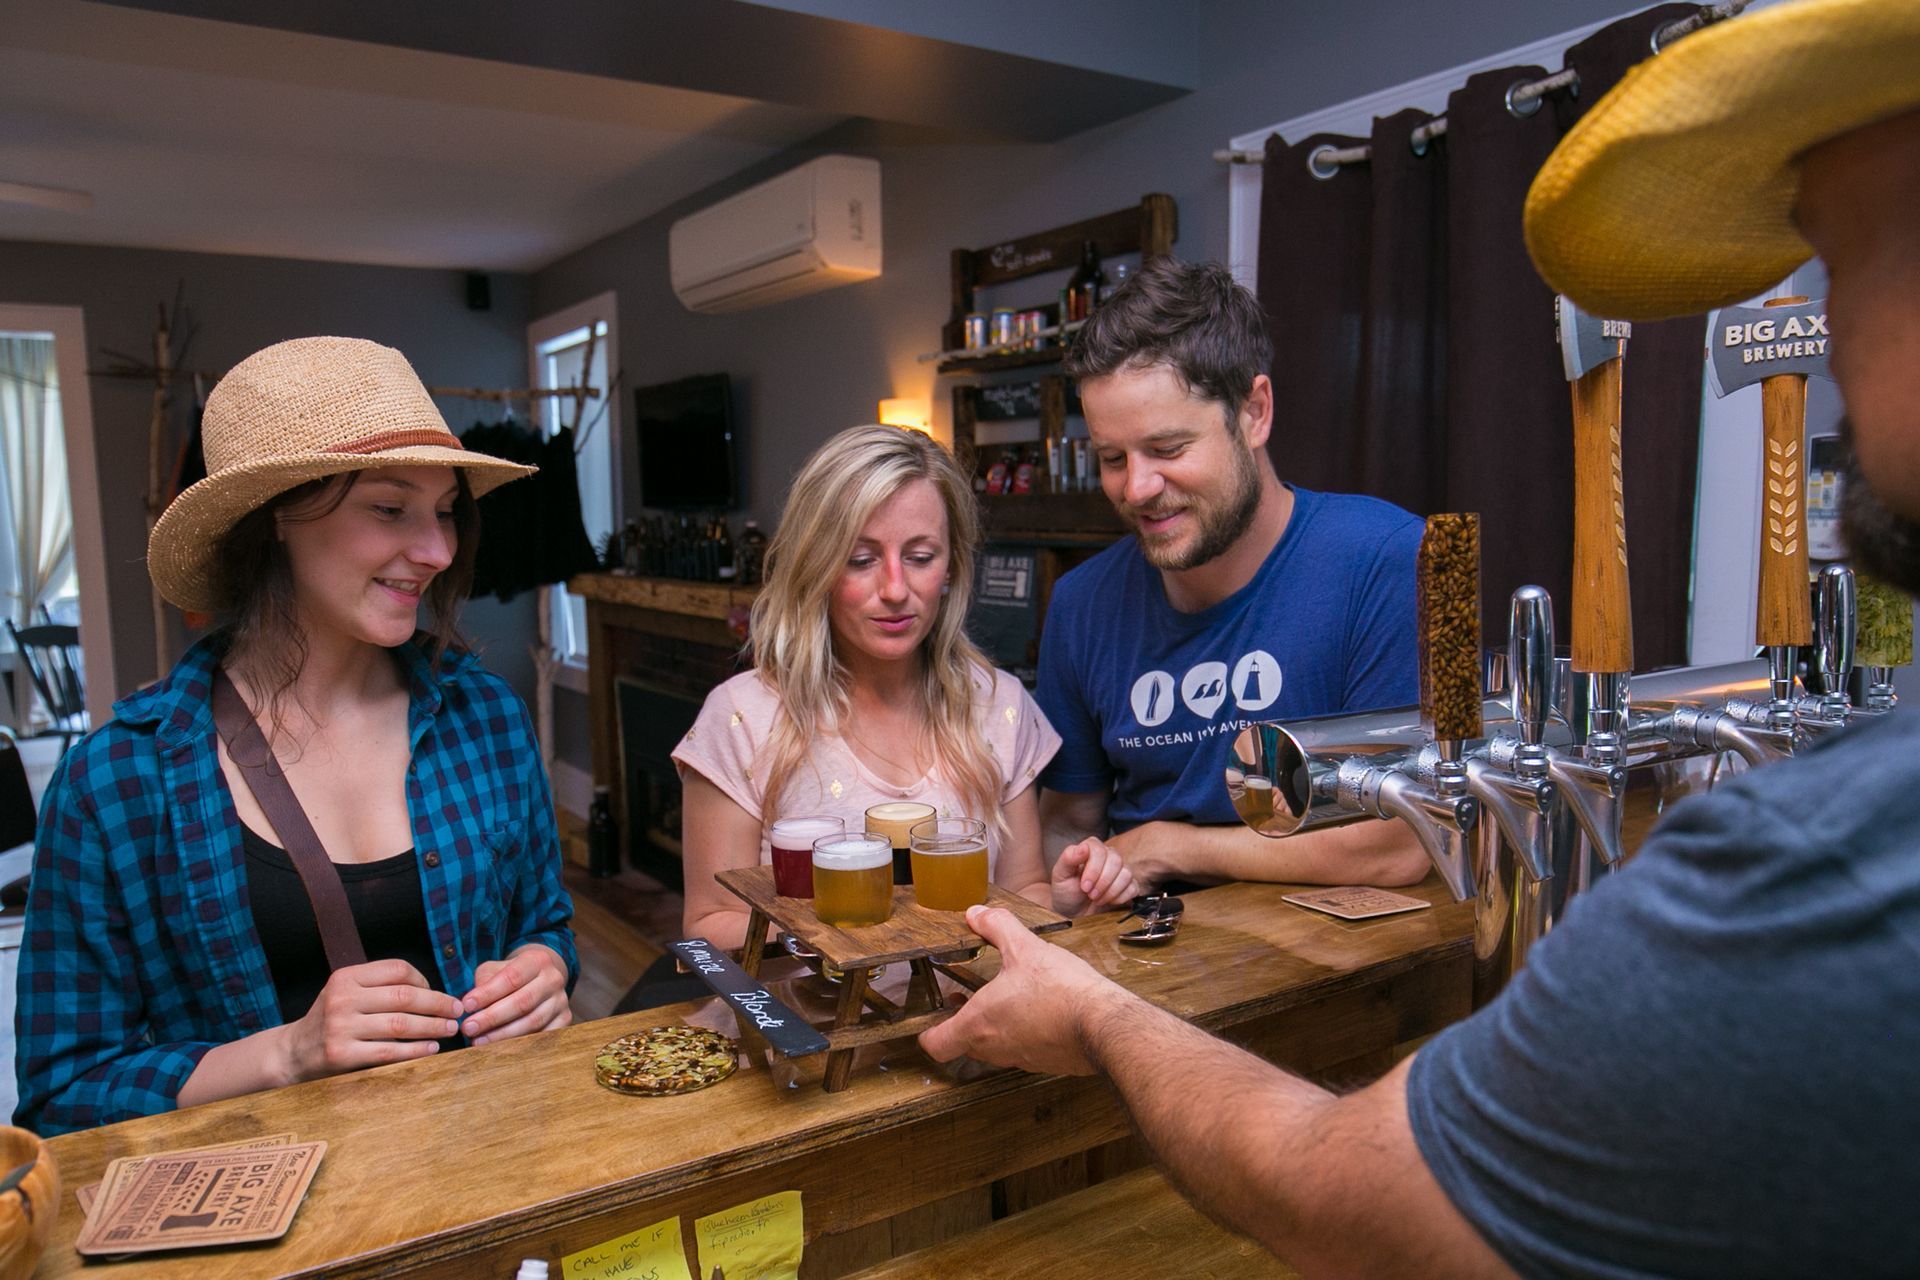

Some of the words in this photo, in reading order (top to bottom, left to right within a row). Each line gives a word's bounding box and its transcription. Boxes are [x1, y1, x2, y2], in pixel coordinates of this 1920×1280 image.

[1602, 320, 1632, 337] BREW
[1725, 320, 1776, 346] BIG
[1781, 314, 1830, 339] AX
[1743, 339, 1827, 364] BREWERY
[1118, 737, 1142, 749] THE
[1145, 731, 1194, 747] OCEAN
[1219, 720, 1257, 734] AVEN
[210, 1166, 247, 1208] BREWERY
[241, 1163, 274, 1189] BIG
[219, 1195, 254, 1228] AXE
[573, 1254, 610, 1272] CALL
[652, 1227, 664, 1242] IF
[605, 1257, 634, 1278] HAVE
